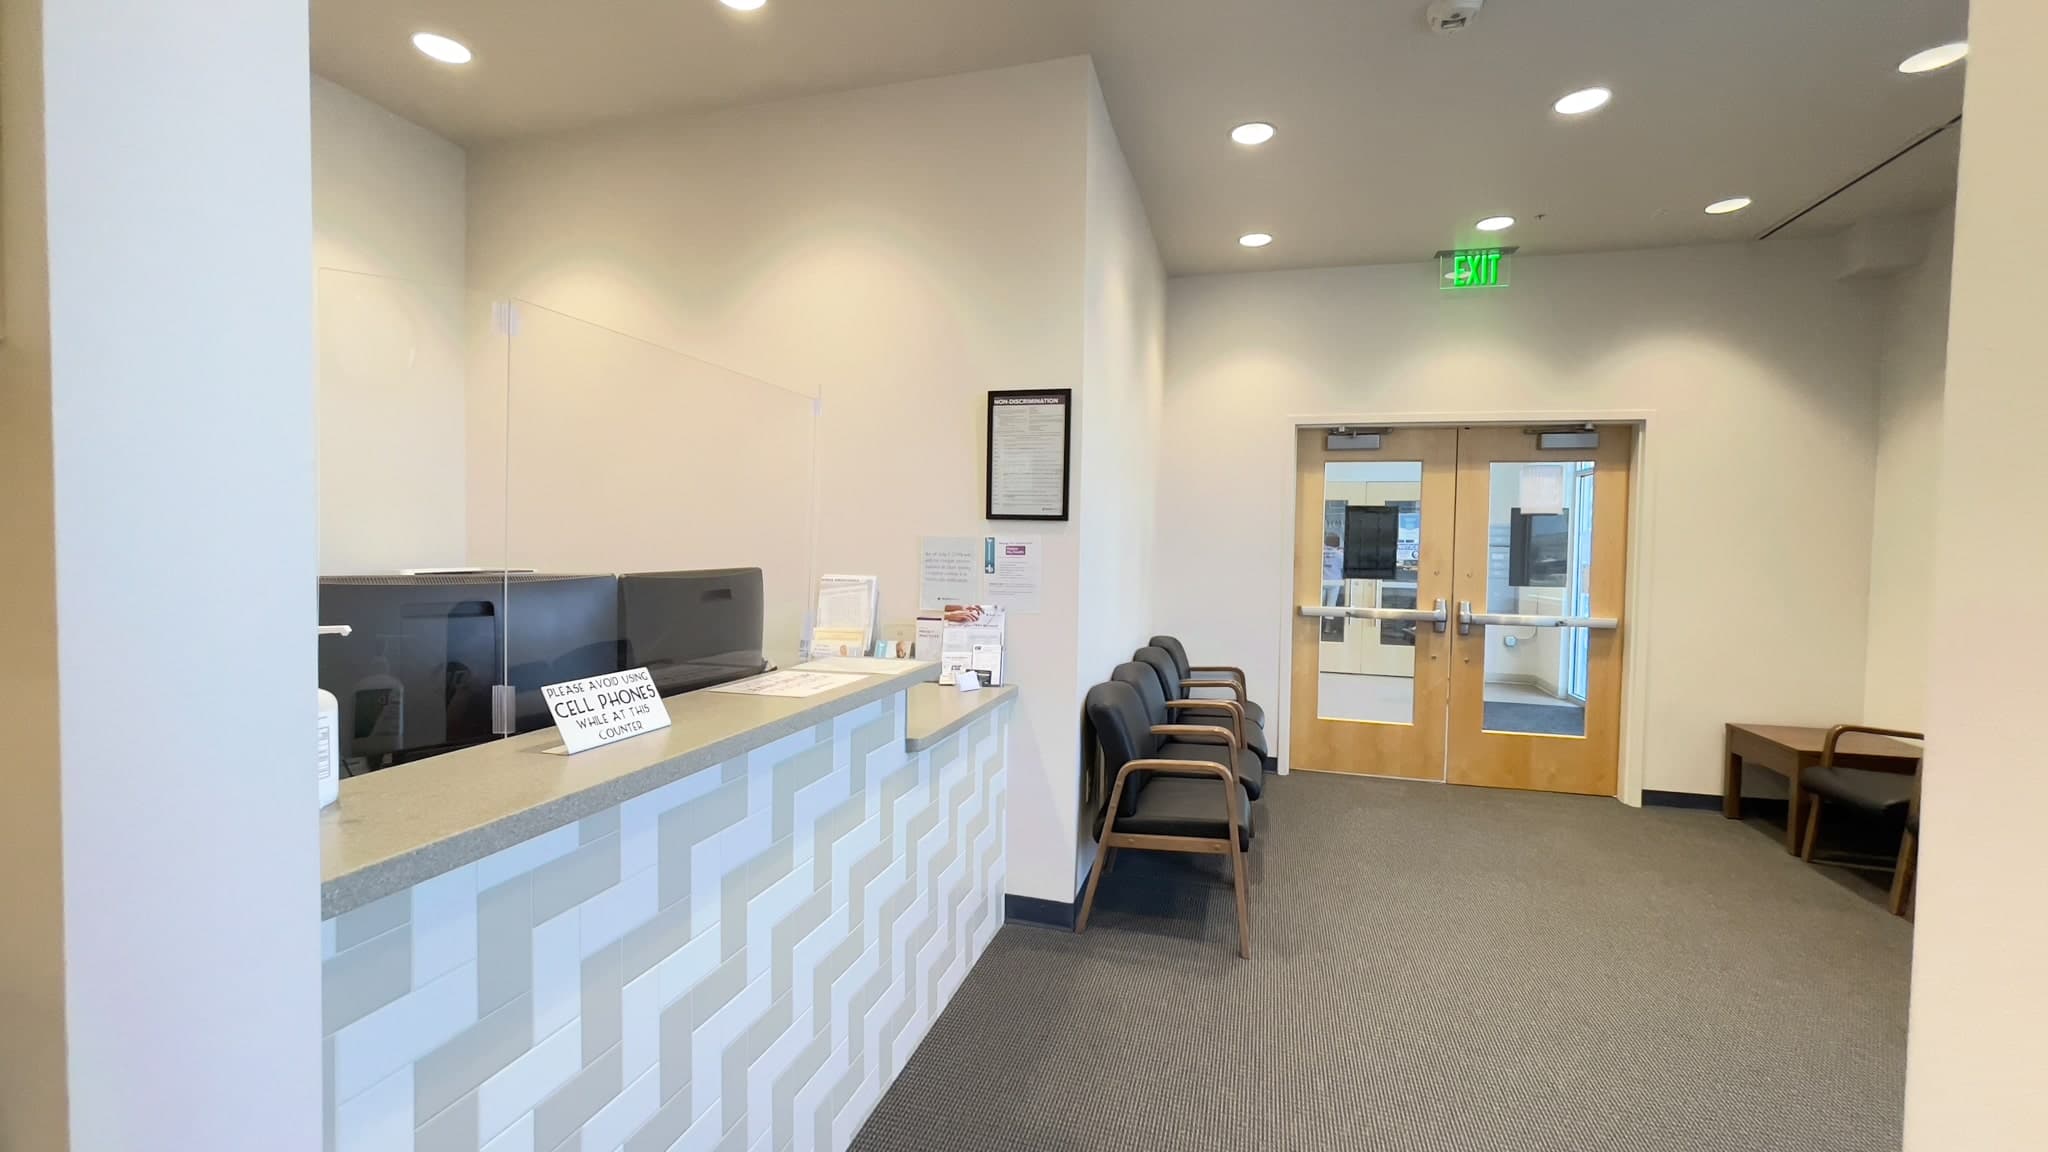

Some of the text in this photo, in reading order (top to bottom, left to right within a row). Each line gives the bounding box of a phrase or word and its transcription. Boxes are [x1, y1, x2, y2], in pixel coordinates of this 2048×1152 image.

[1454, 254, 1501, 287] EXIT
[993, 397, 1059, 405] NON-DISCRIMINATION
[546, 671, 649, 698] PLEASE AVOID USING
[554, 684, 656, 718] CELL PHONES
[576, 704, 650, 729] WHILE AT THIS
[599, 720, 643, 740] COUNTER
